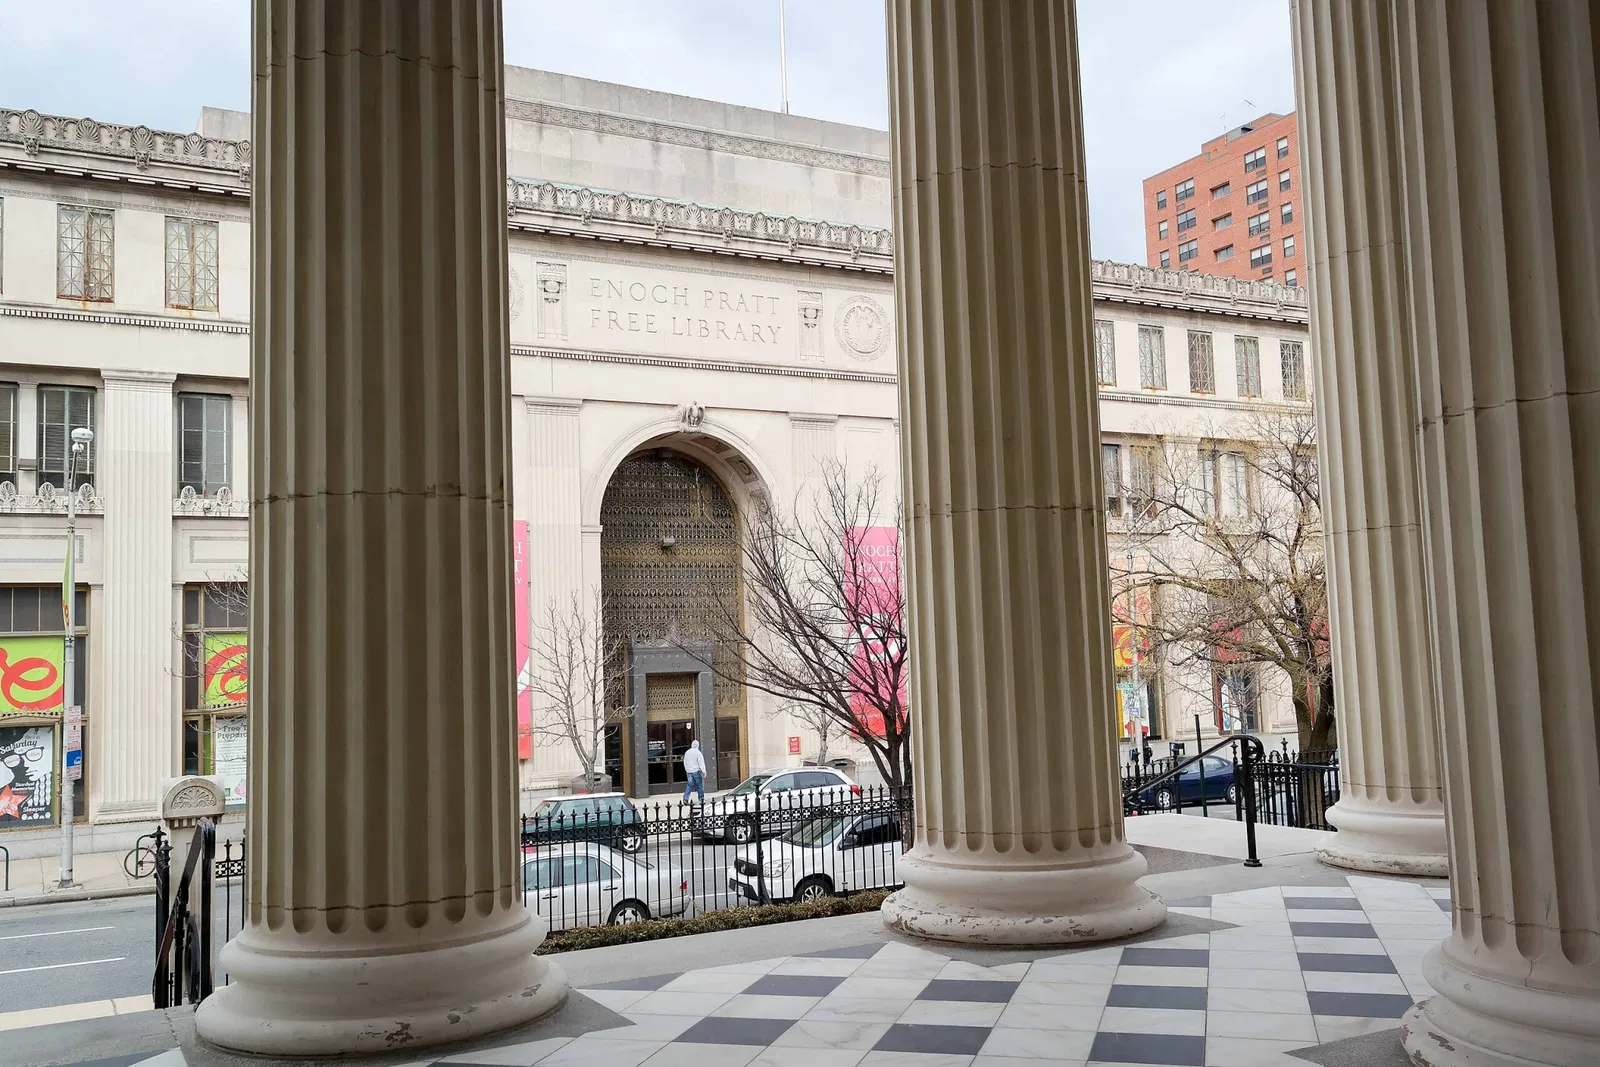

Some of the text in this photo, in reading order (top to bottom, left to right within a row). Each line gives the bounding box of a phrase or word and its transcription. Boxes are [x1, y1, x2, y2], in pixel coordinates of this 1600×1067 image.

[590, 277, 780, 315] ENOCH PRATT
[590, 308, 782, 344] FREE LIBRARY
[850, 545, 897, 557] NOCH
[0, 740, 38, 754] Saturday
